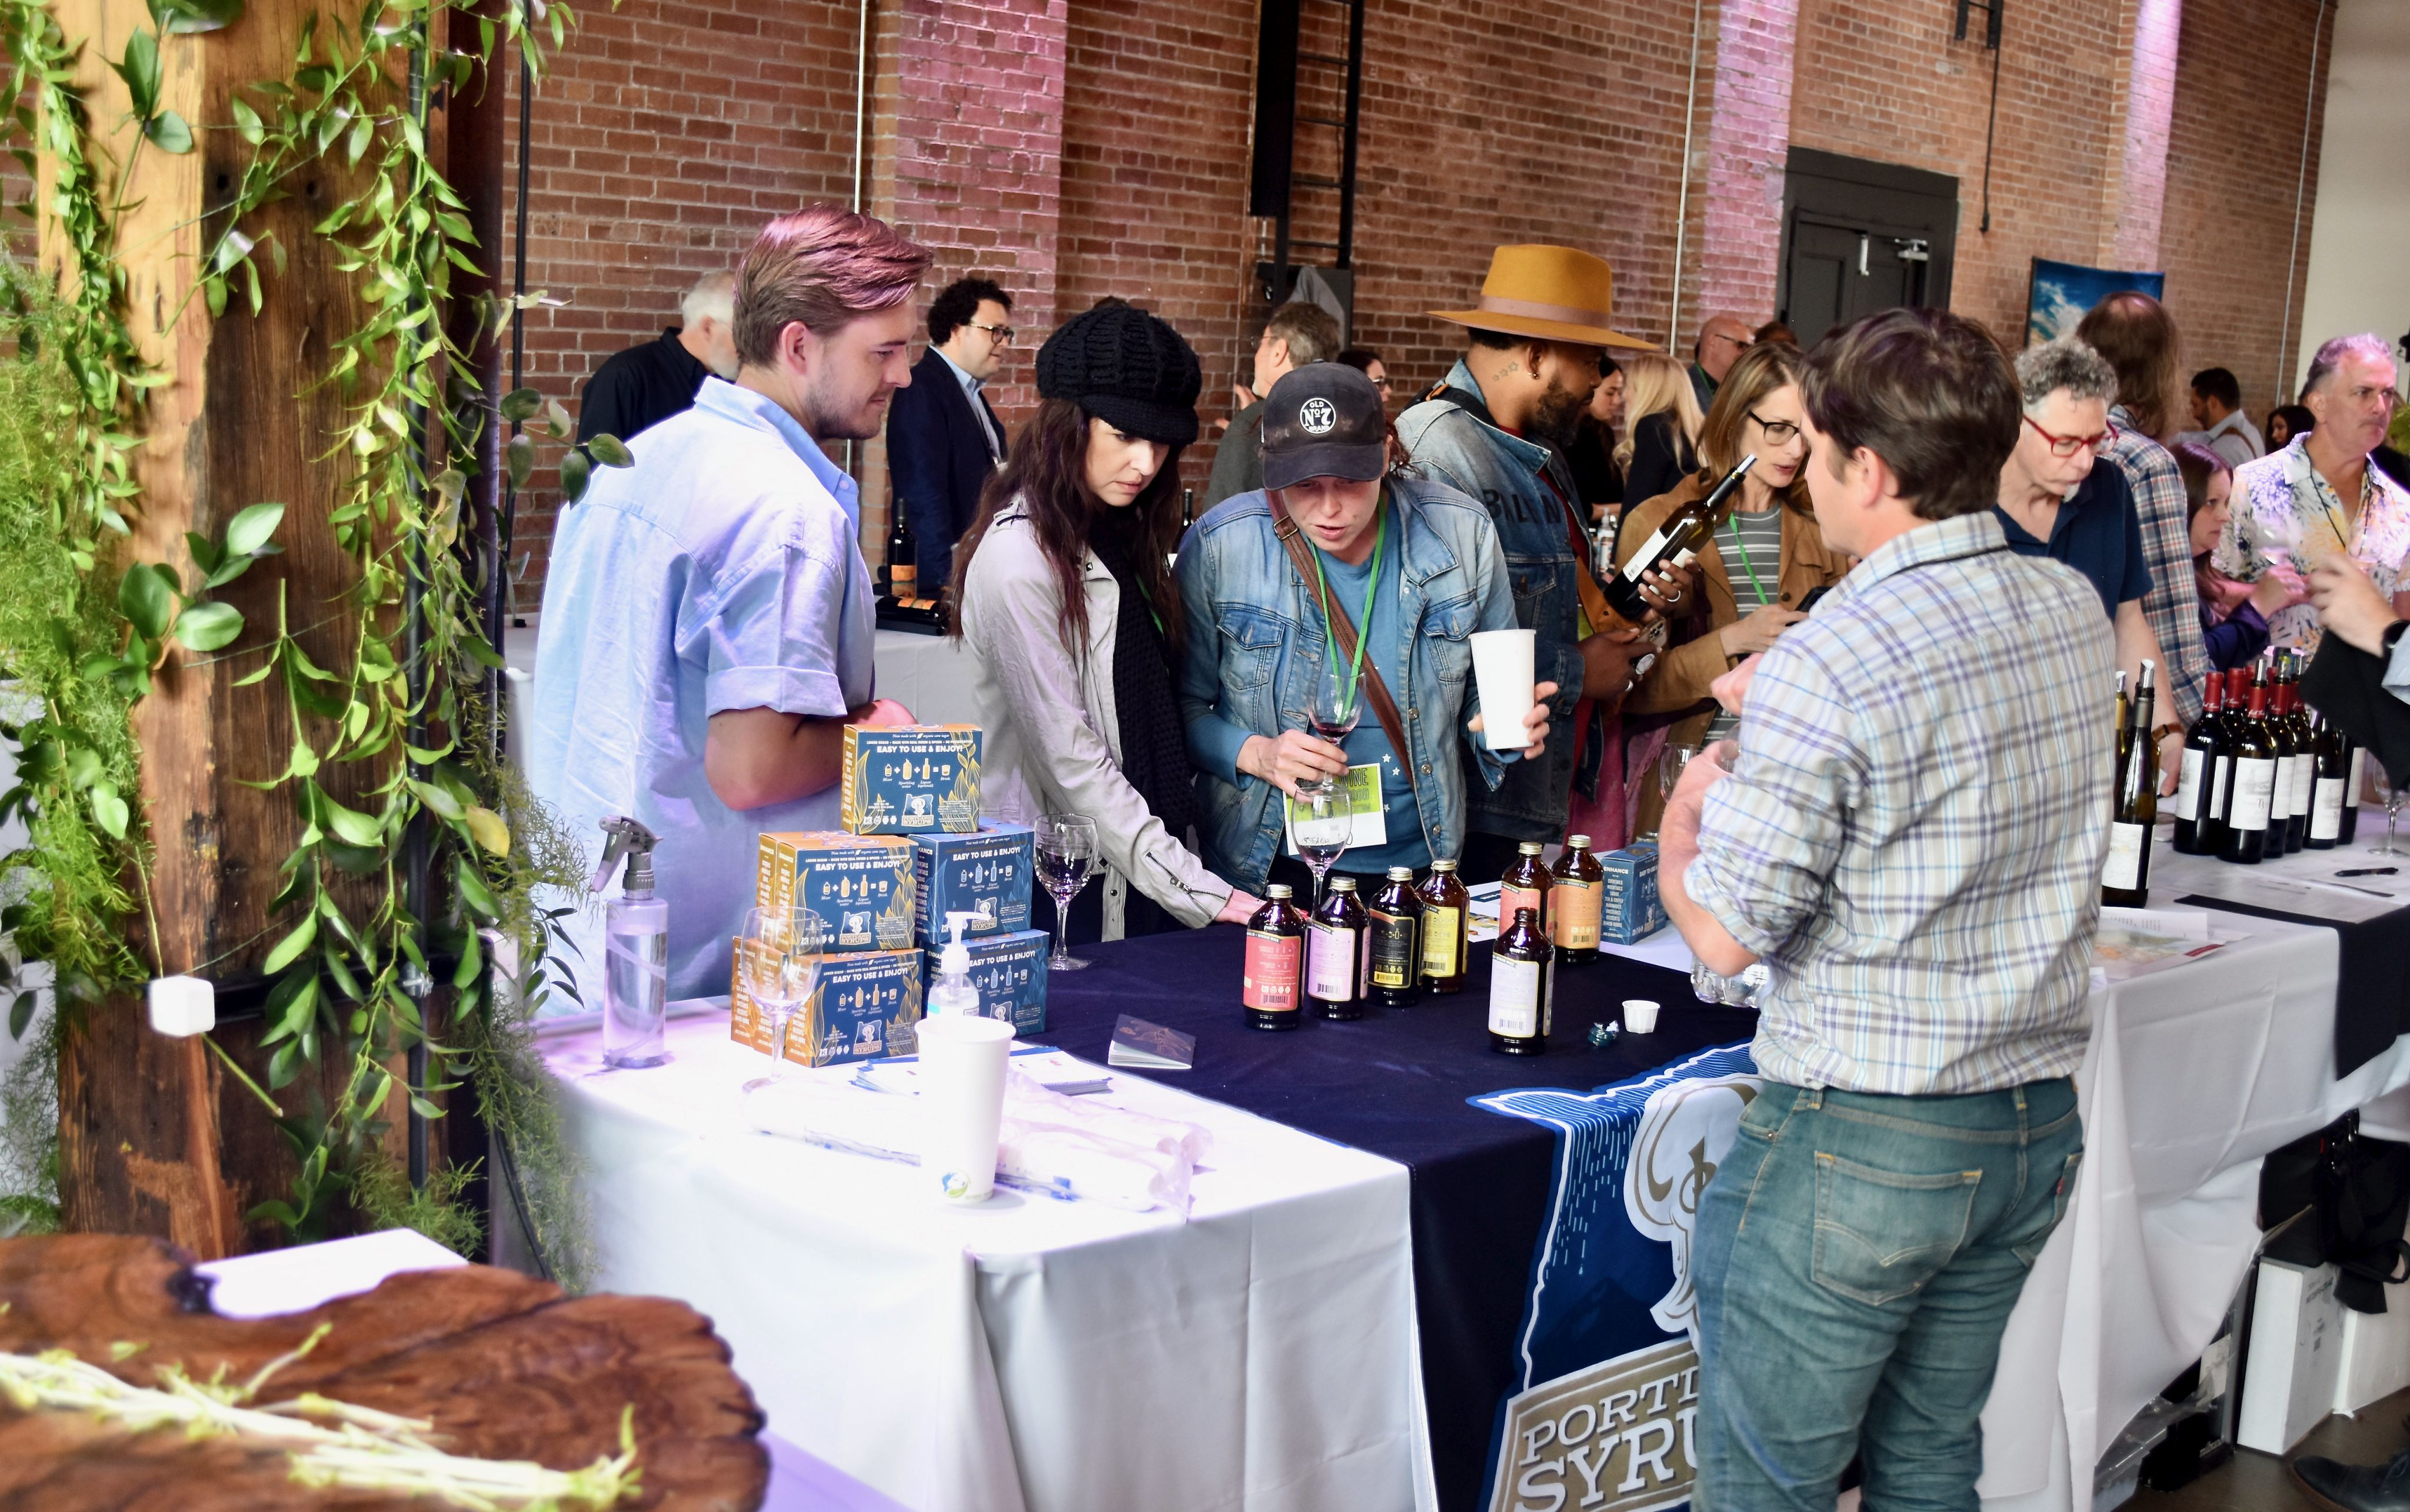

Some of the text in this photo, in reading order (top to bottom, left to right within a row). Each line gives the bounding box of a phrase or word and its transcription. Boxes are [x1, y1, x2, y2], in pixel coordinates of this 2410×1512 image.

[1339, 768, 1368, 787] WINE
[953, 853, 970, 861] EASY
[999, 847, 1020, 855] ENJOY!
[1603, 866, 1629, 874] ENHANCE
[969, 958, 986, 967] EASY
[996, 955, 1008, 963] USE
[1014, 950, 1036, 960] ENJOY!
[833, 975, 850, 984] EASY
[884, 968, 908, 977] ENJOY!
